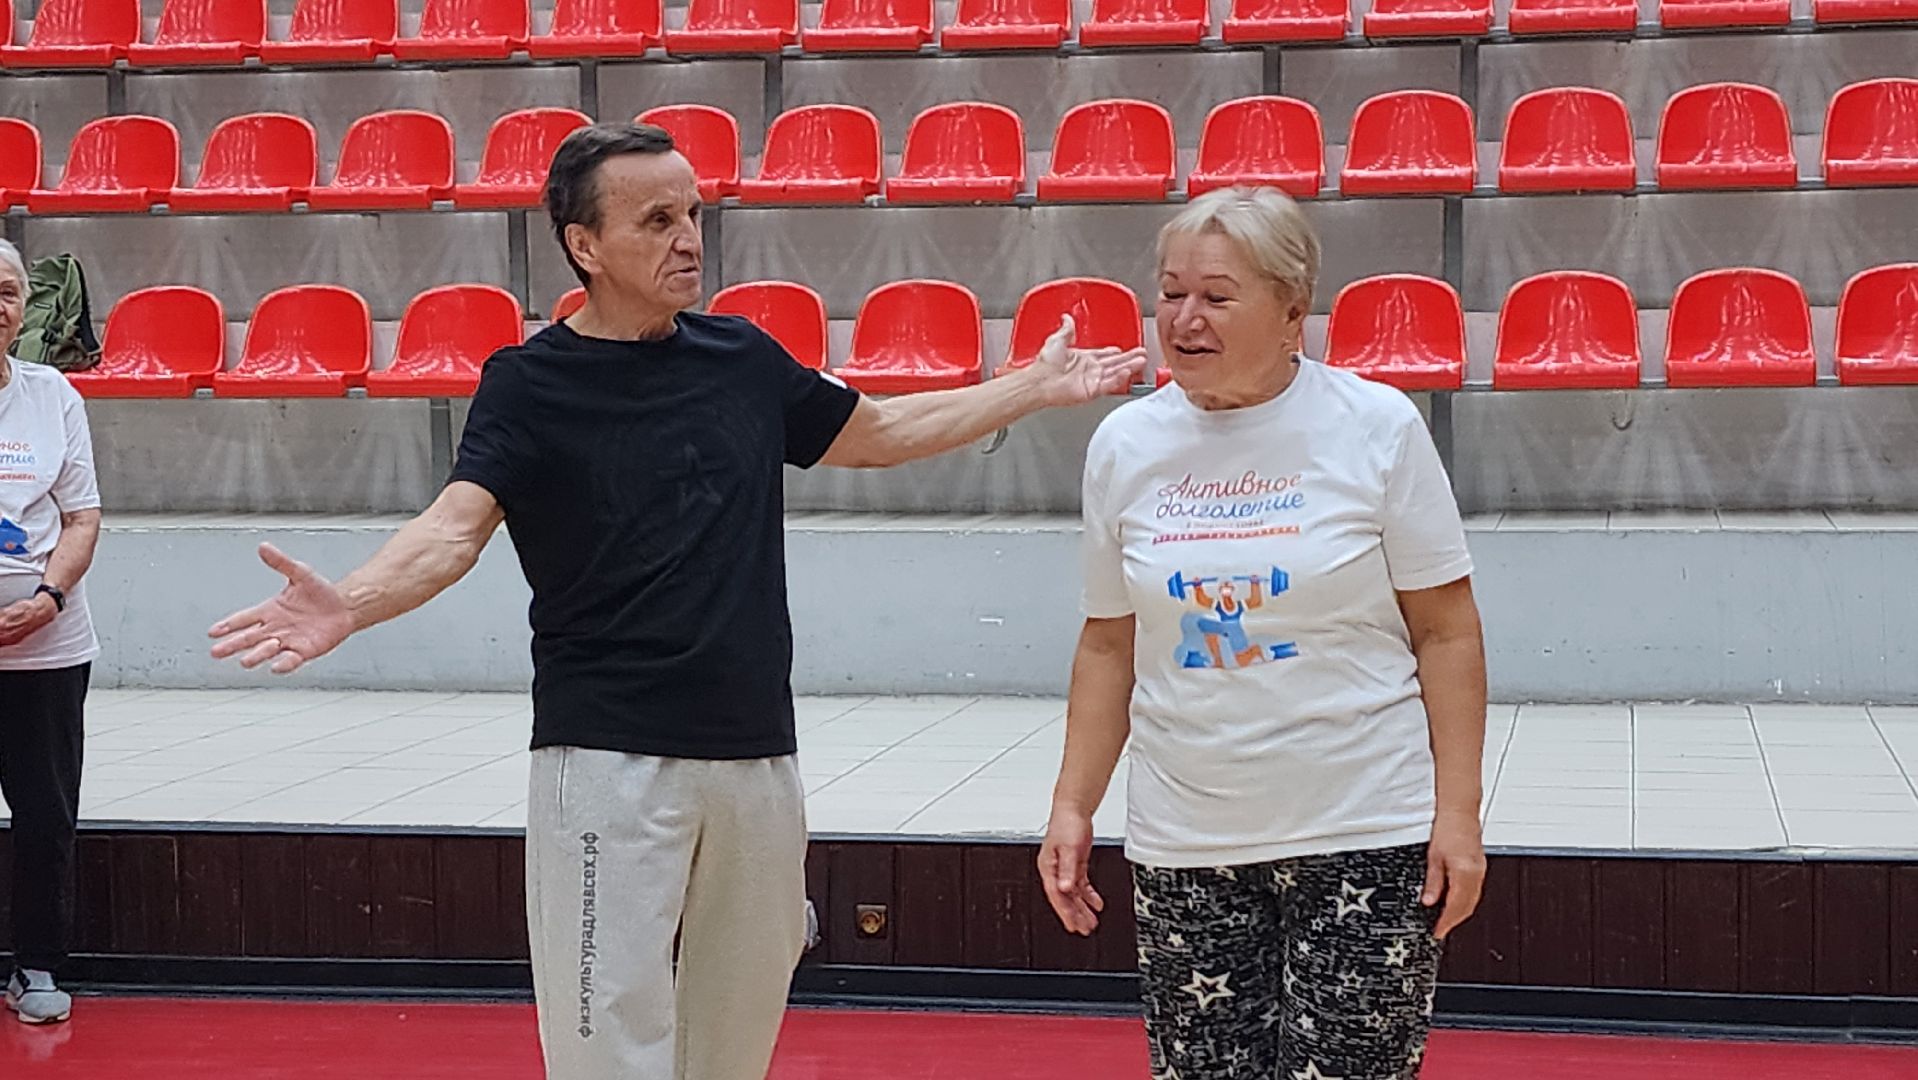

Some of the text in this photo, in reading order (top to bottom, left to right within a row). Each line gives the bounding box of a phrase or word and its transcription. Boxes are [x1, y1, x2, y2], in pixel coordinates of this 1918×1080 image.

[1157, 470, 1302, 500] Активное
[1156, 493, 1306, 519] долголетие
[578, 832, 599, 1038] физкультурадлявсех.рф
